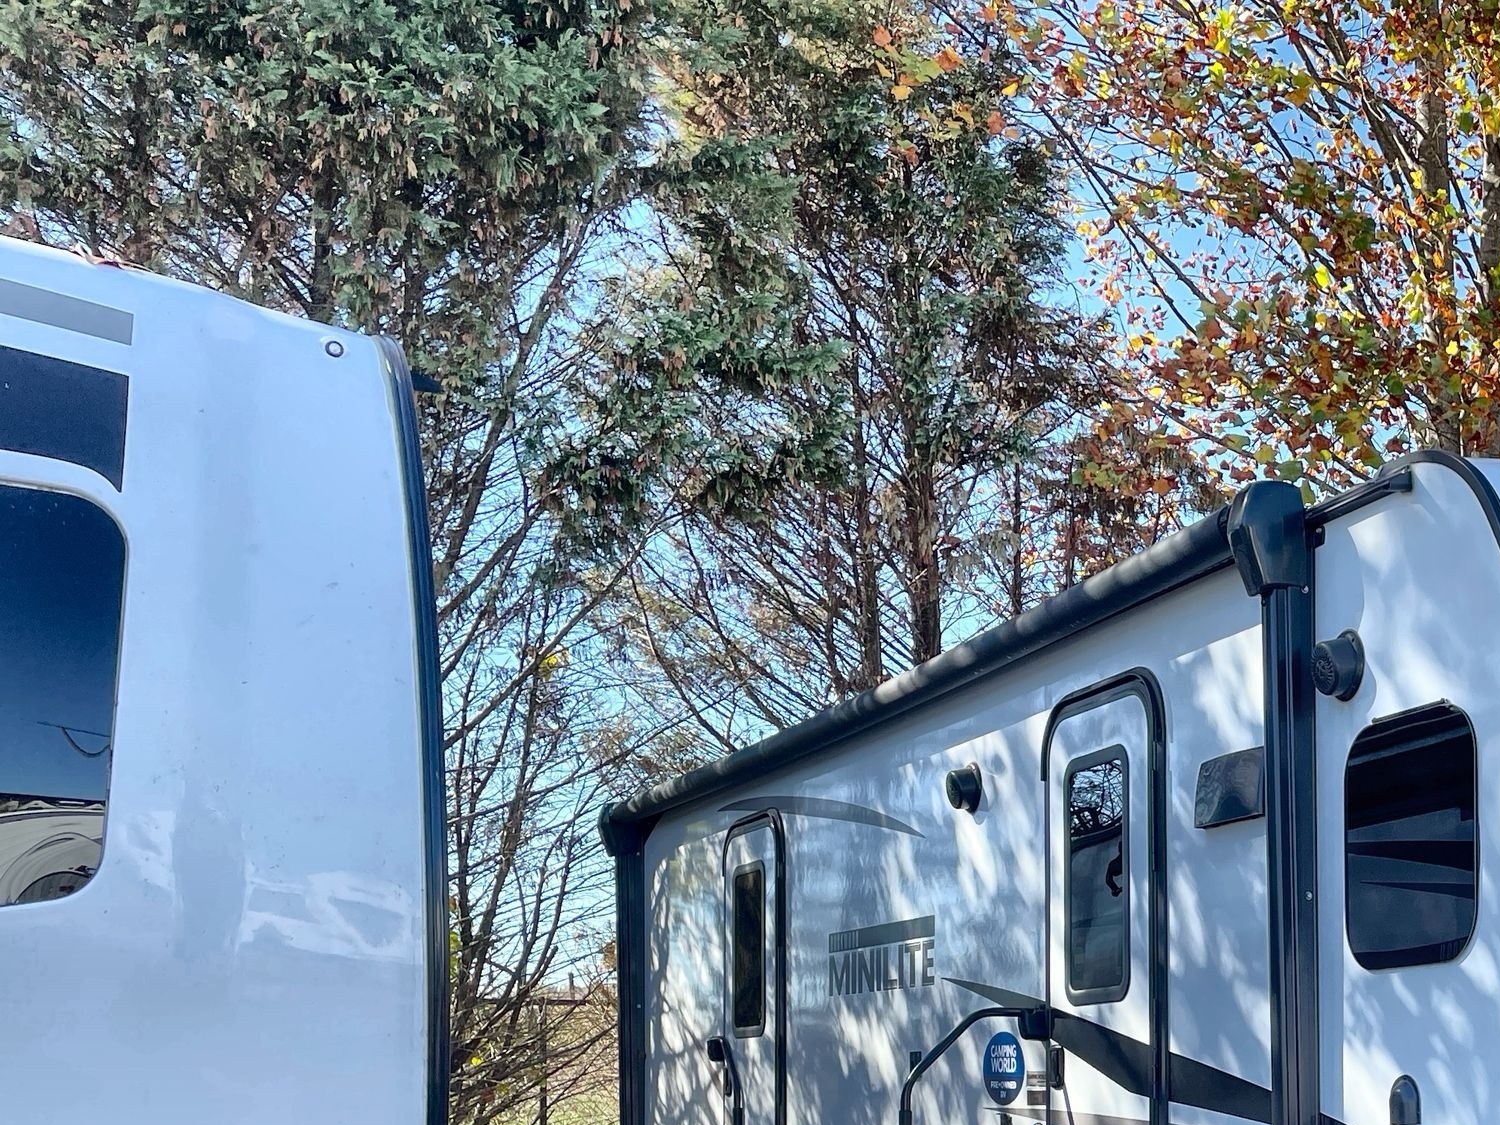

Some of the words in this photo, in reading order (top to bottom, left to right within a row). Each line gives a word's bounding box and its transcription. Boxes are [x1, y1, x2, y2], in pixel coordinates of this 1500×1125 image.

[828, 939, 935, 997] MINILITE
[990, 1044, 1017, 1058] CAMPING
[990, 1058, 1017, 1073] WORLD
